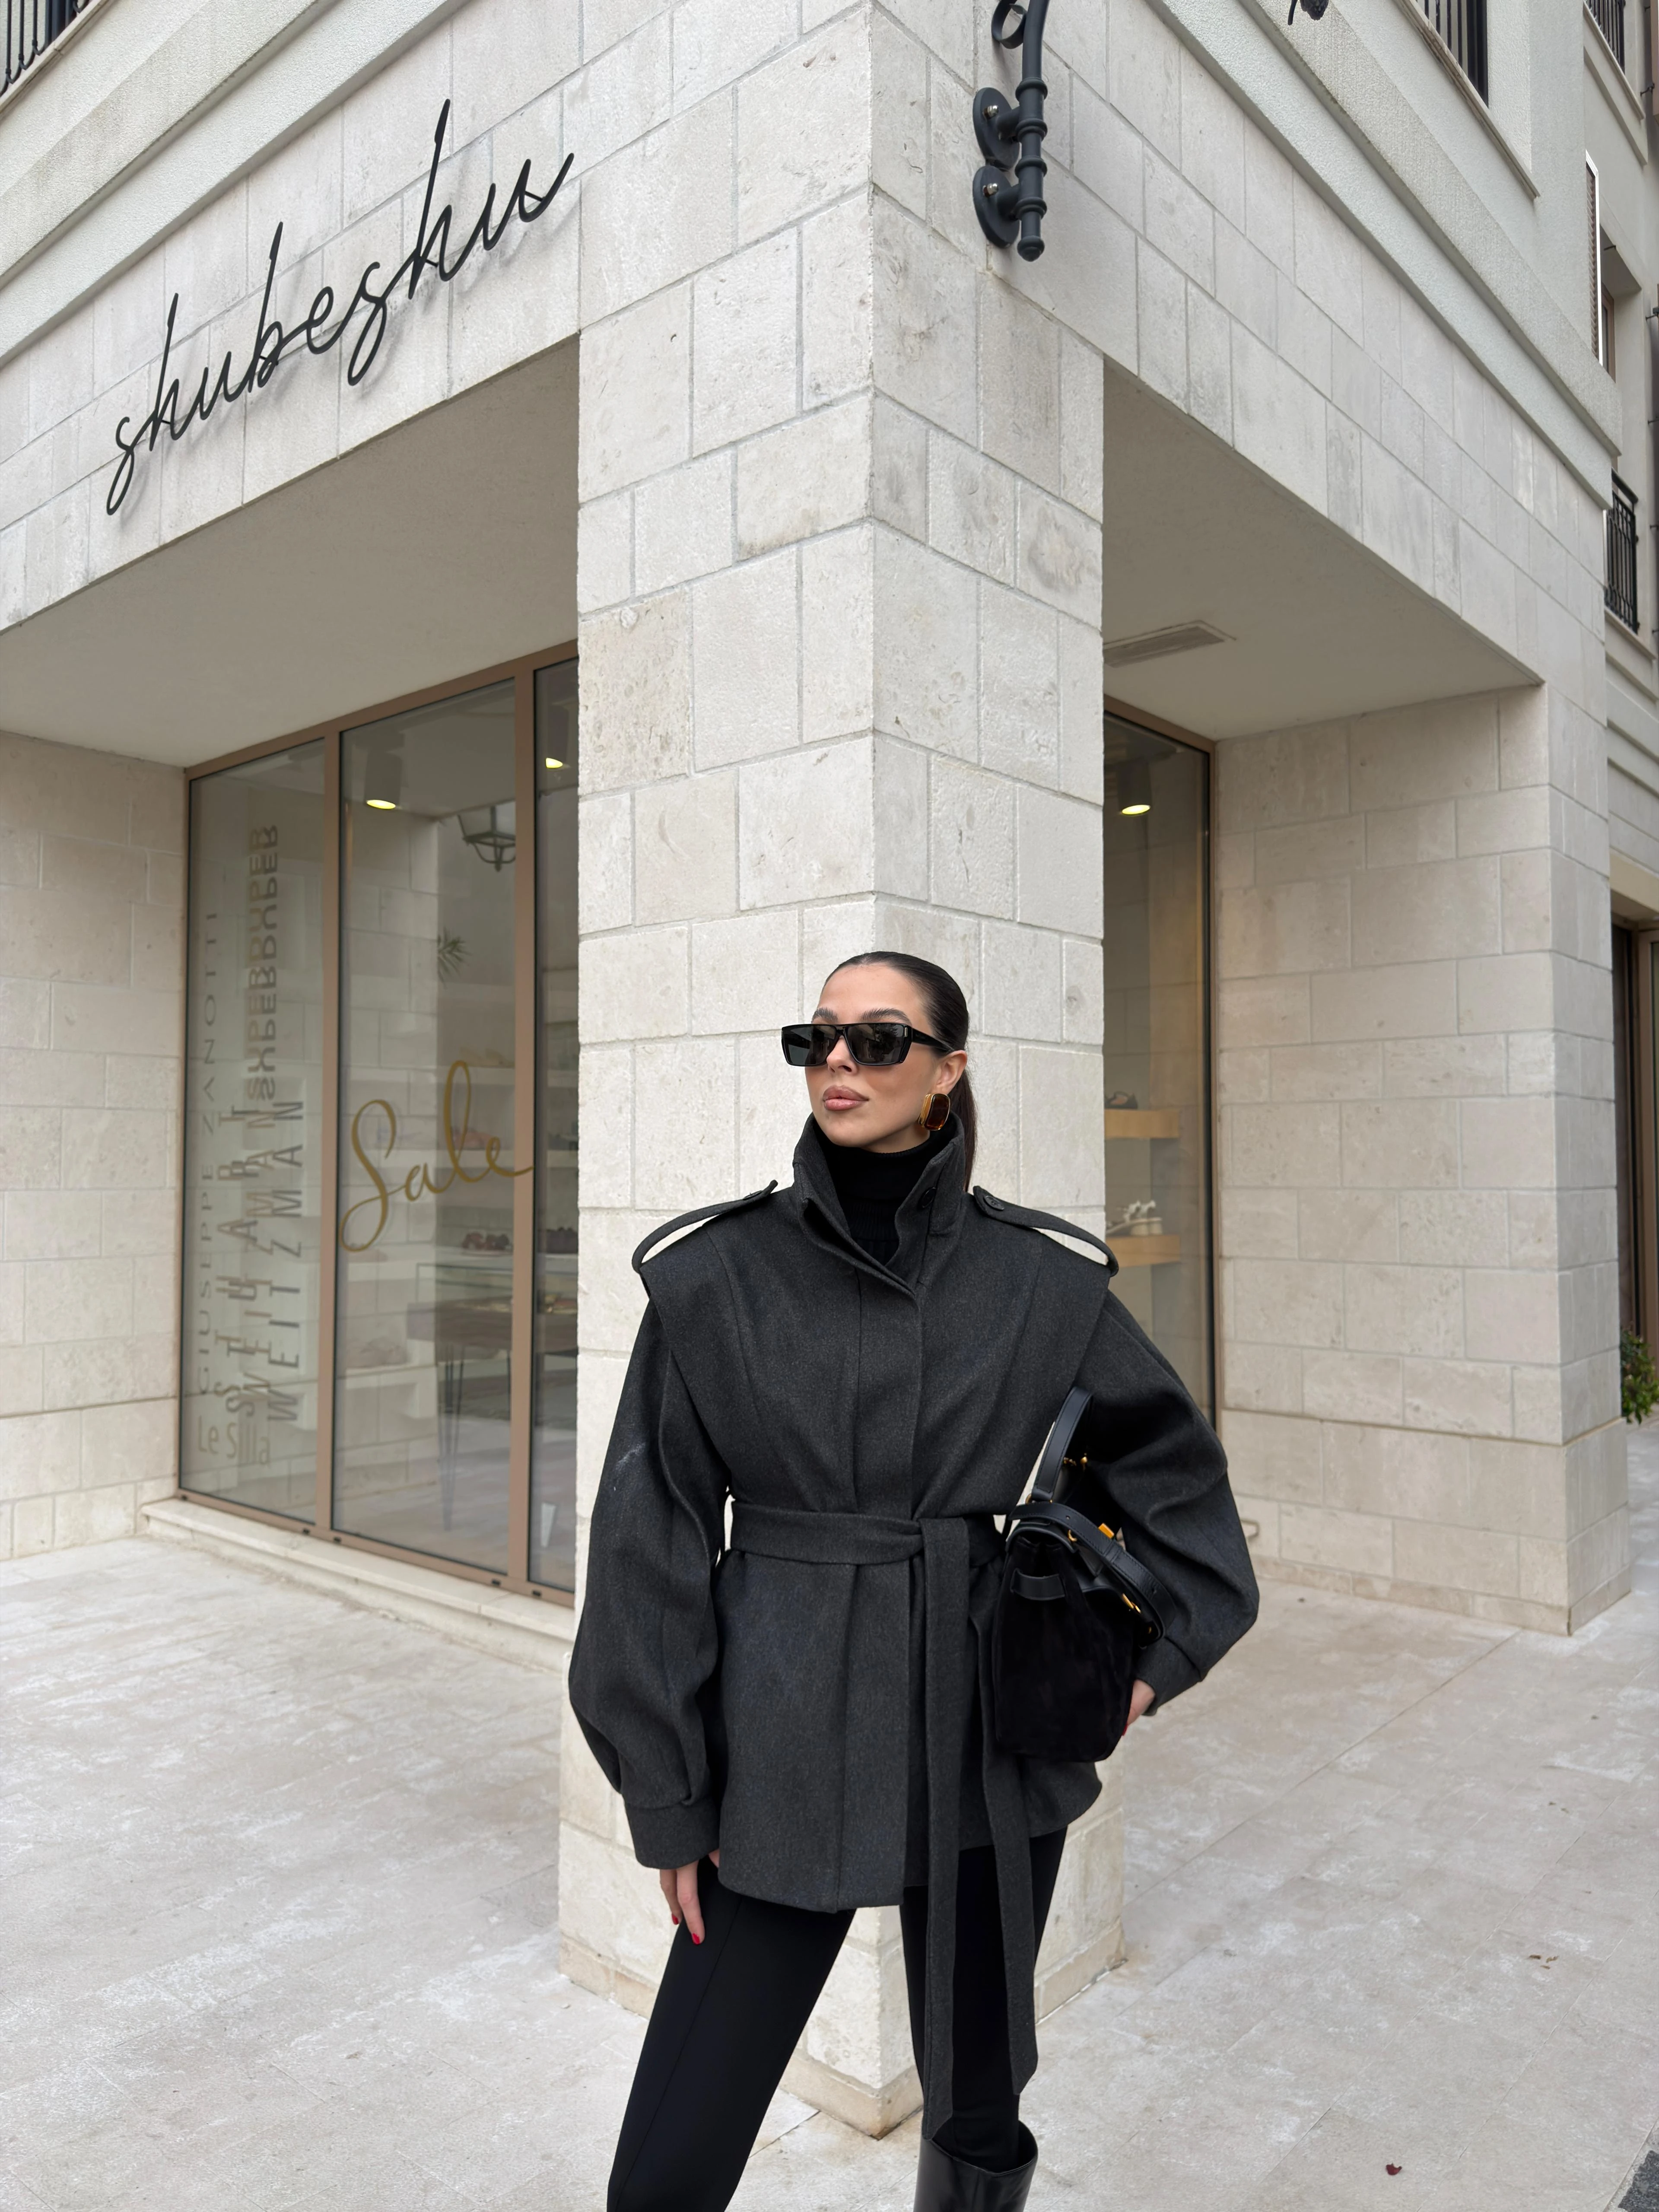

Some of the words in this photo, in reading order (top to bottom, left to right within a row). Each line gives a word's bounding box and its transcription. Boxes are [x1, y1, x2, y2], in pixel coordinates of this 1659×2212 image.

[106, 98, 575, 515] shubeshu
[202, 913, 218, 1136] ZANOTTI
[226, 1104, 260, 1417] STUART
[266, 1102, 303, 1421] WEITZMAN
[338, 1060, 534, 1251] Sale
[198, 1164, 213, 1395] GIUSEPPE
[197, 1415, 219, 1455] Le
